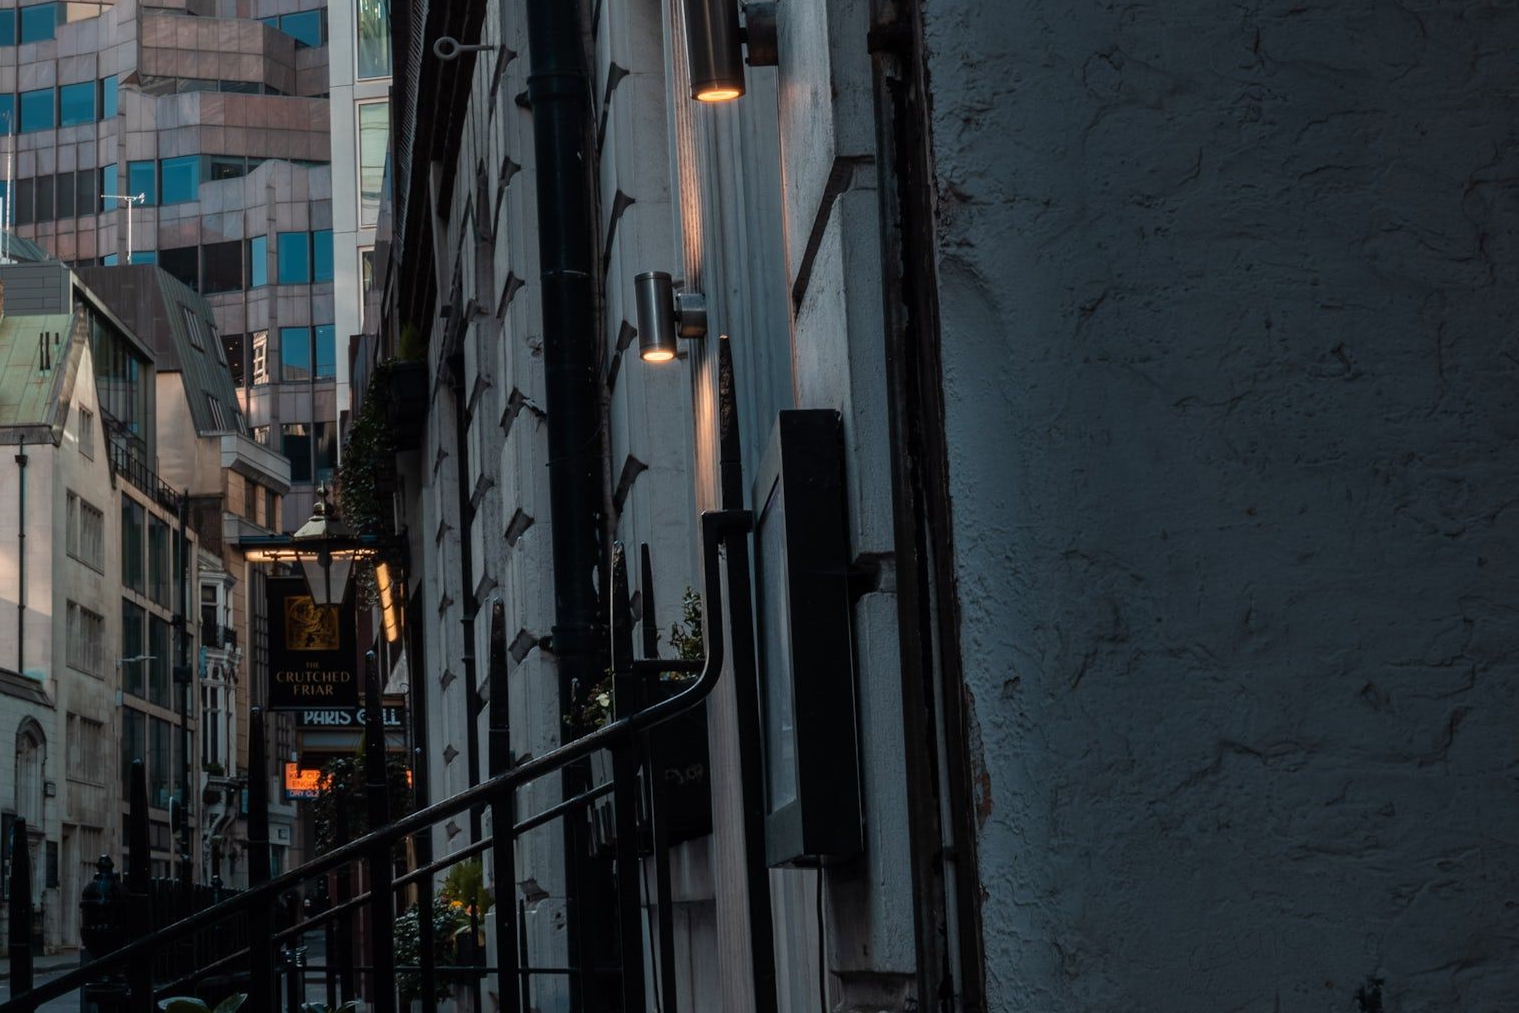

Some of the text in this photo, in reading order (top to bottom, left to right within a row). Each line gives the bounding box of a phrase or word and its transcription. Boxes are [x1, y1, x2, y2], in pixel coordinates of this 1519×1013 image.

[305, 660, 320, 669] THE
[276, 671, 351, 683] CRUTCHED
[293, 684, 335, 696] FRIAR
[303, 710, 352, 725] PARIS
